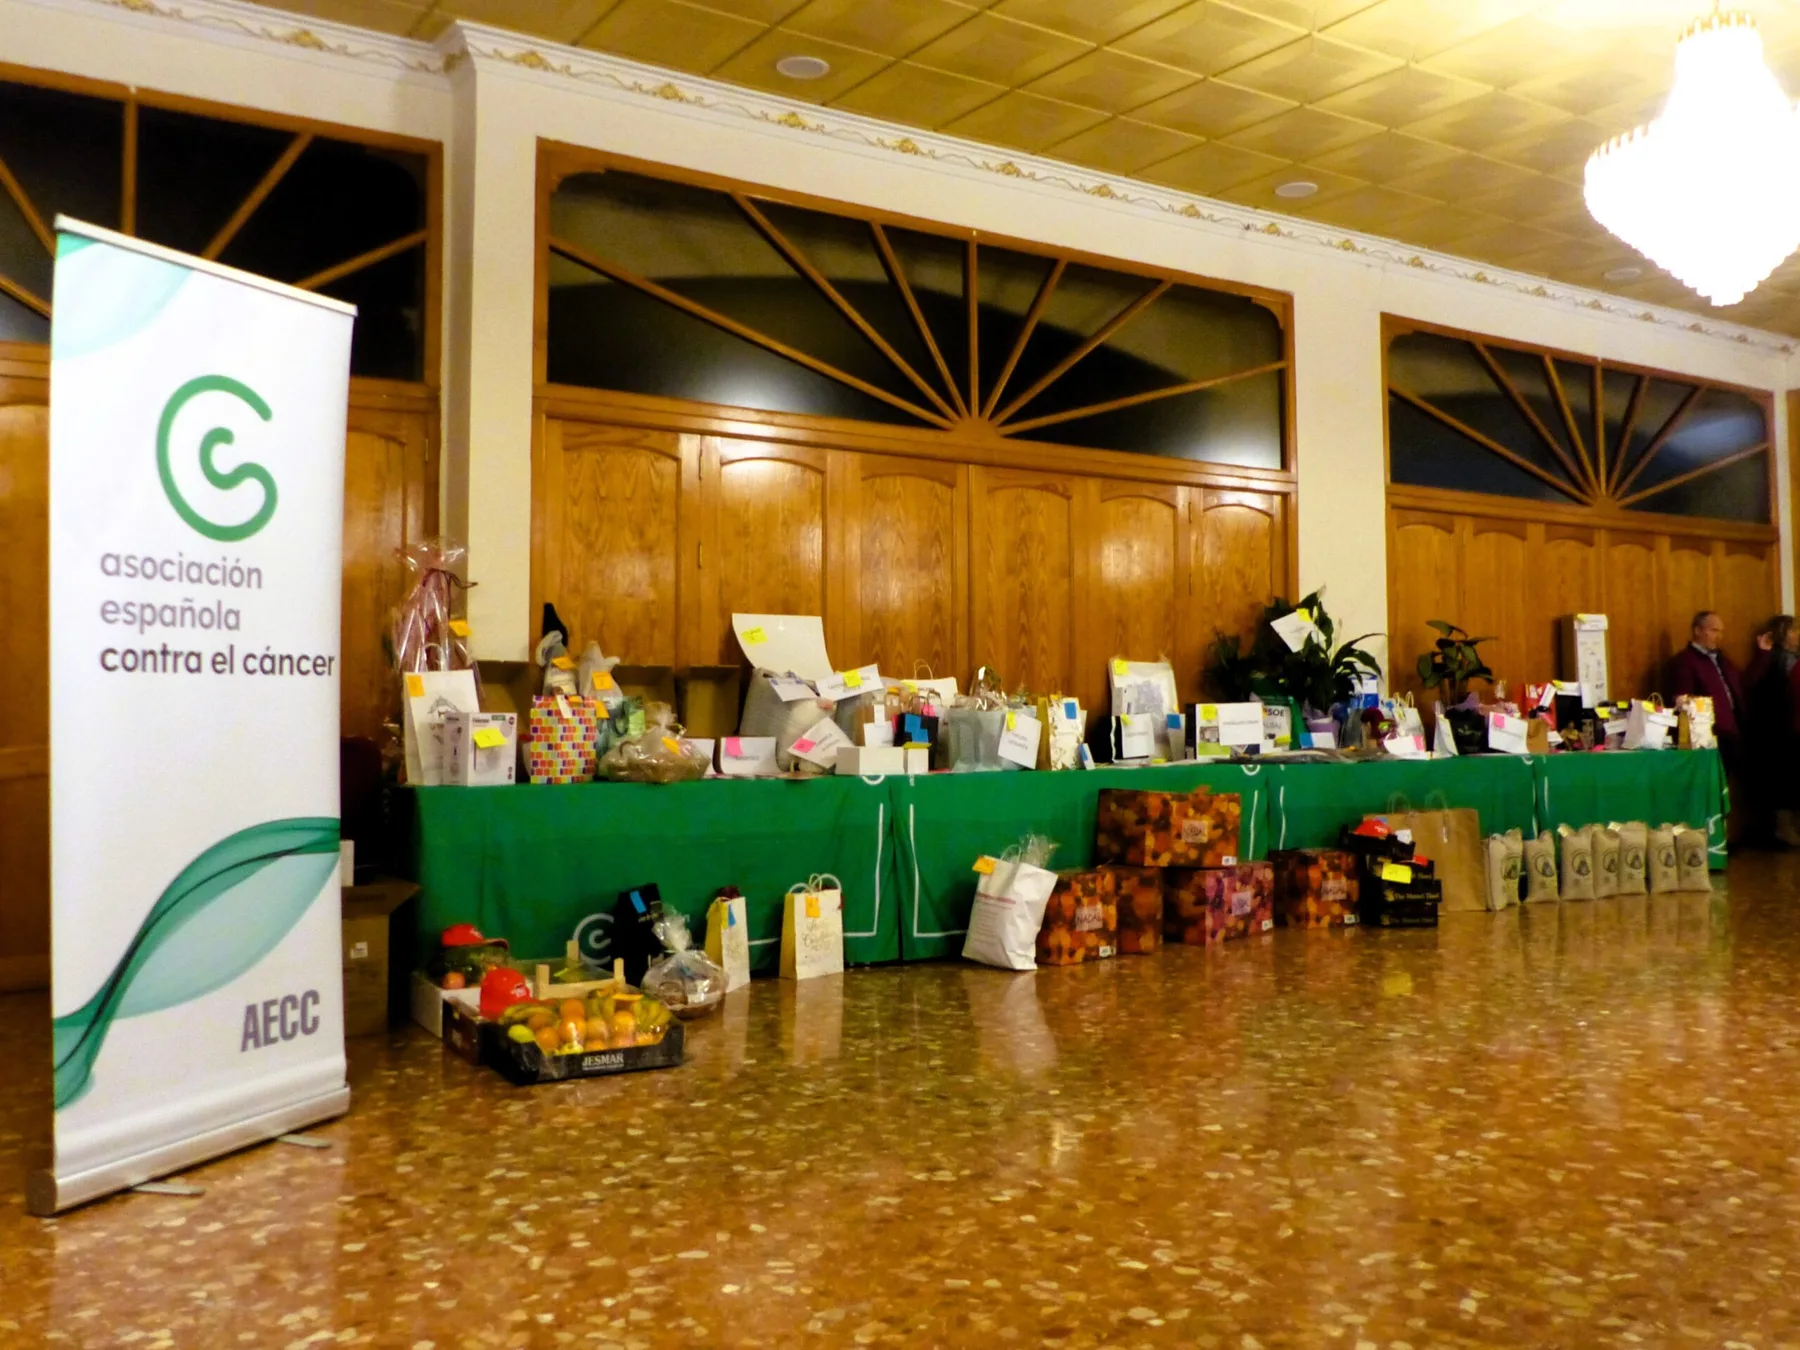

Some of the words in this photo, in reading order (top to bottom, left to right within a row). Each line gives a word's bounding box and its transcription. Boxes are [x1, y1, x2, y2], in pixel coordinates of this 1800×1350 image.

[100, 552, 262, 589] asociación
[100, 598, 240, 634] española
[100, 643, 202, 673] contra
[211, 644, 234, 674] el
[242, 645, 335, 676] cáncer
[241, 989, 320, 1052] AECC
[582, 1053, 624, 1066] JESMAR
